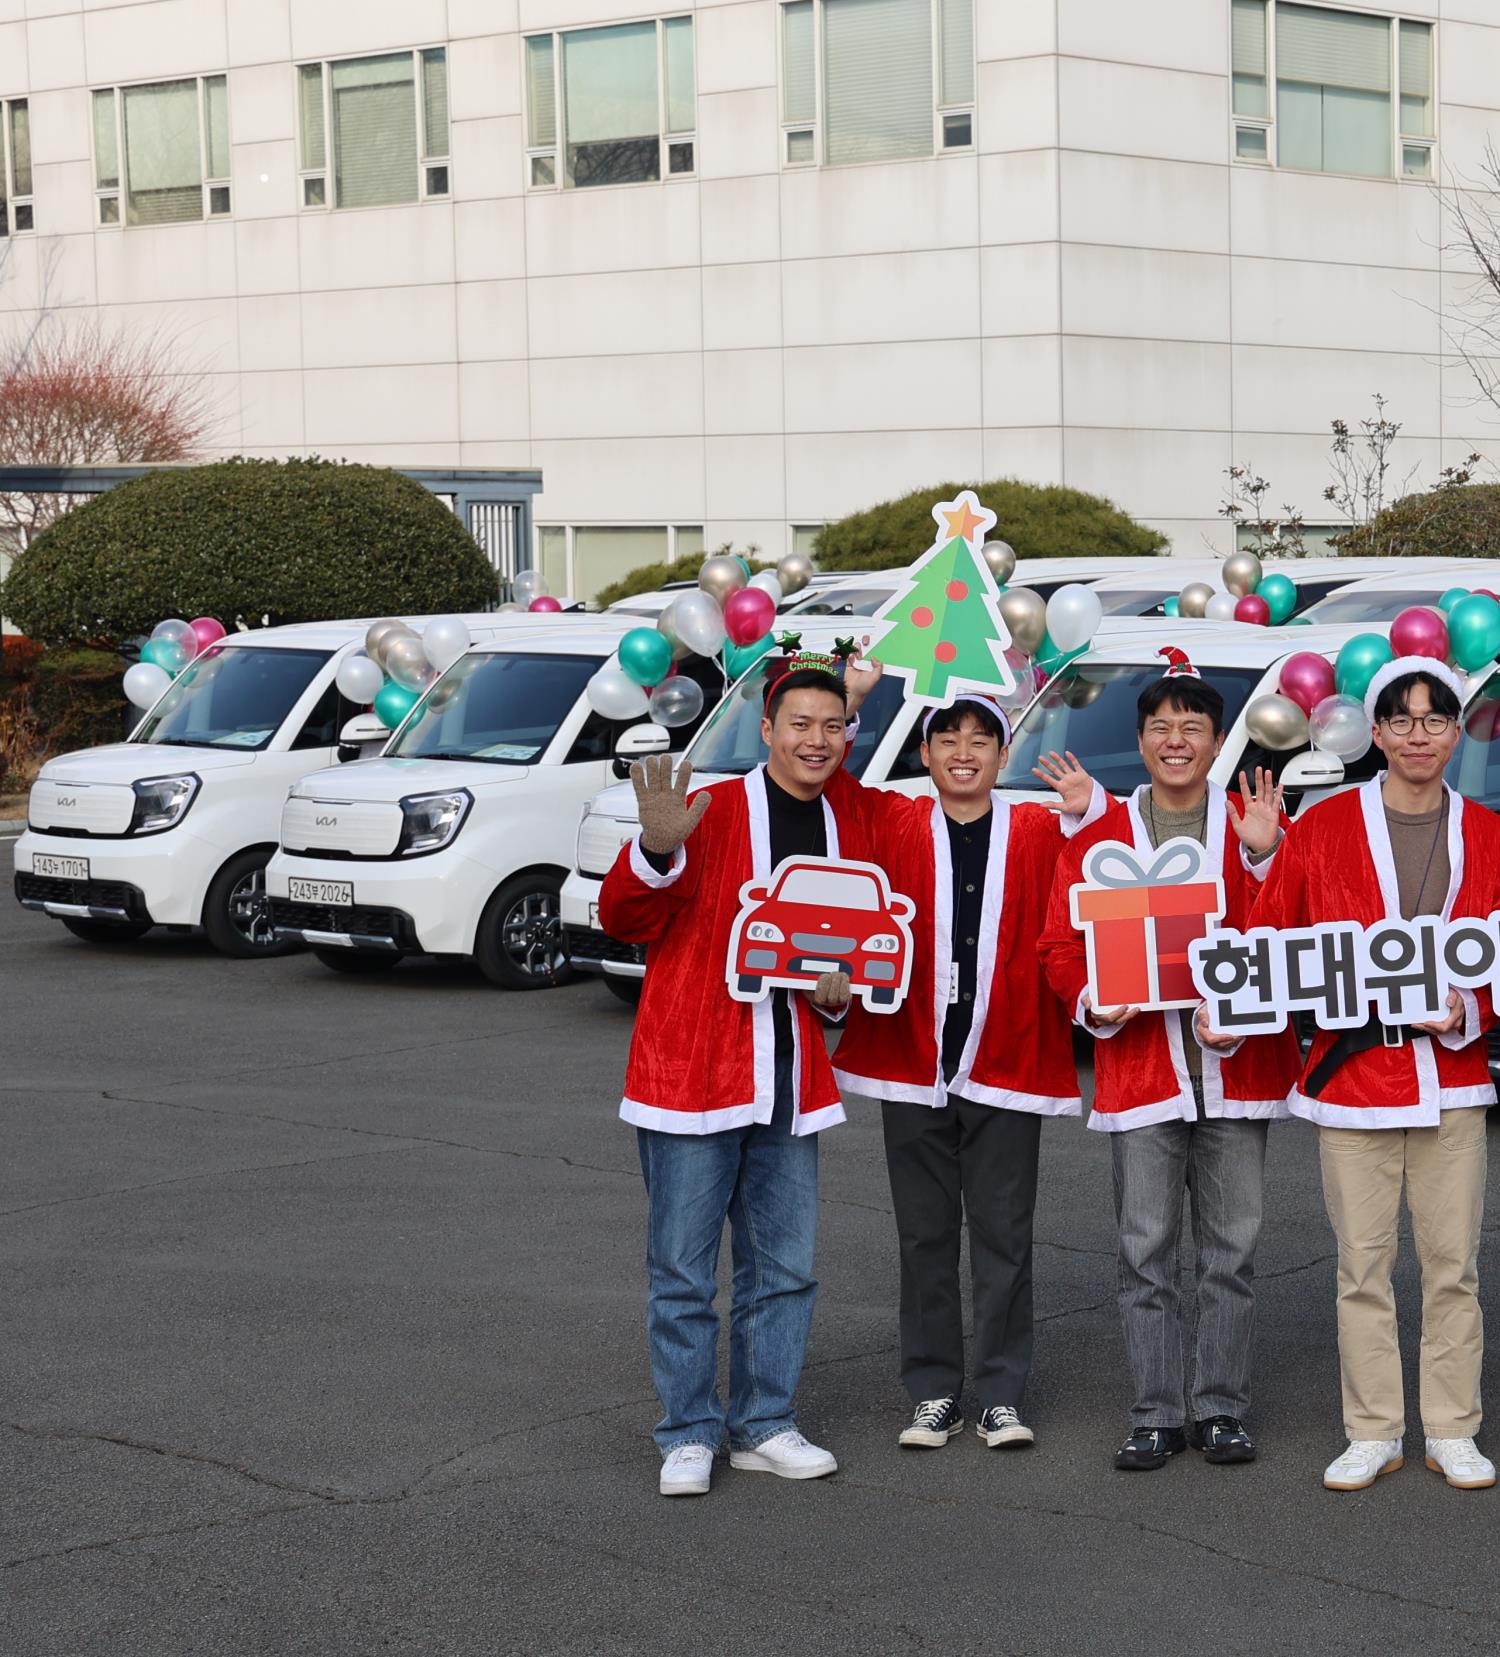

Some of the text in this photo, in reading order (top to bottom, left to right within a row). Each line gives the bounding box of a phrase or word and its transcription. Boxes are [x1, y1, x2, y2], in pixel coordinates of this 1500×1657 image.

[799, 651, 835, 664] Merry
[789, 661, 838, 677] Christmas
[60, 860, 84, 877] 1701
[293, 881, 350, 903] 243부 2026
